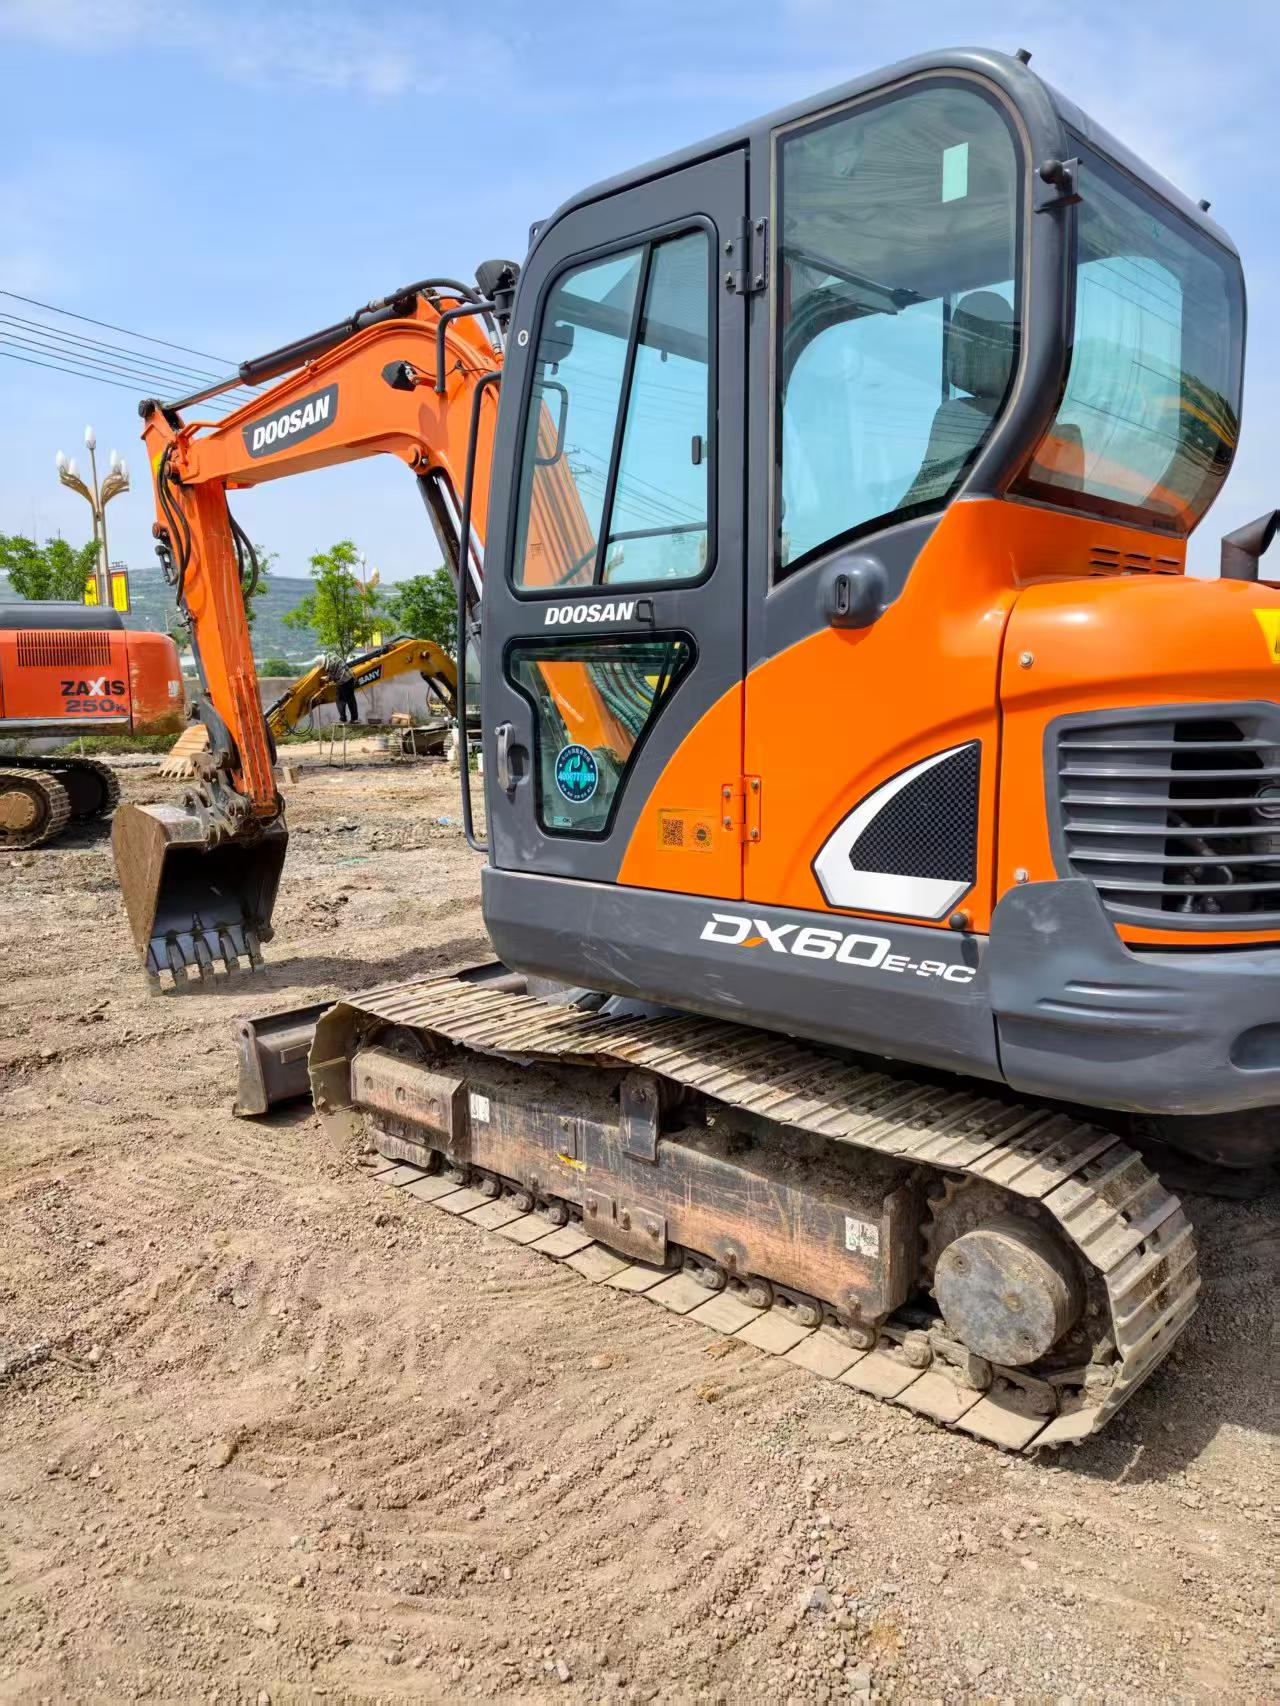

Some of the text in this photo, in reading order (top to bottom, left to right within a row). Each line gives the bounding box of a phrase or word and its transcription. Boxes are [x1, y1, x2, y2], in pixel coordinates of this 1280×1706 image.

[253, 395, 330, 451] DOOSAN
[544, 602, 635, 625] DOOSAN
[61, 677, 126, 696] ZAXIS
[358, 669, 380, 686] SANY
